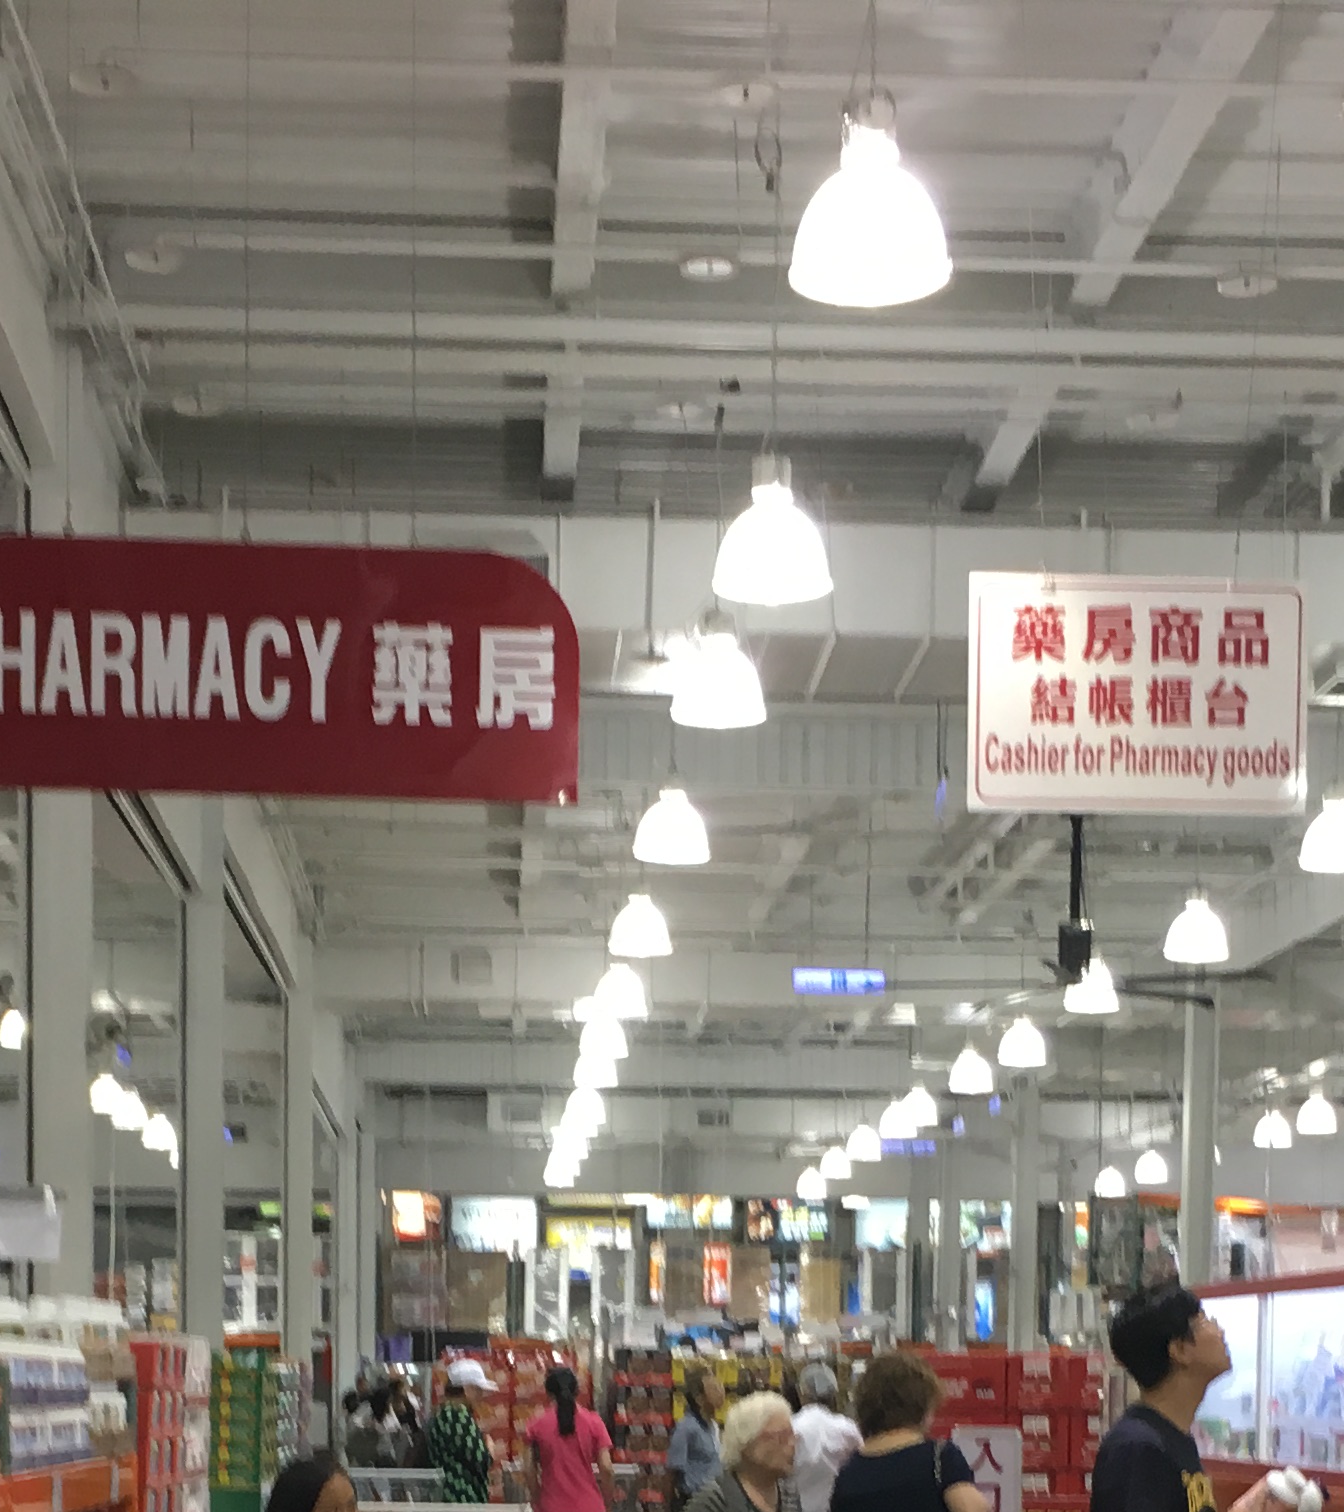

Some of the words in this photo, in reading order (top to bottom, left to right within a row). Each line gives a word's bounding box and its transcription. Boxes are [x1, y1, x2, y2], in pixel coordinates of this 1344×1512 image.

[1011, 602, 1270, 667] 藥房商品
[371, 619, 555, 732] 藥房
[1029, 673, 1250, 730] 結帳櫃台
[984, 731, 1069, 776] Cashier
[1074, 732, 1105, 776] for
[1109, 734, 1218, 787] Pharmacy
[1223, 738, 1291, 788] goods
